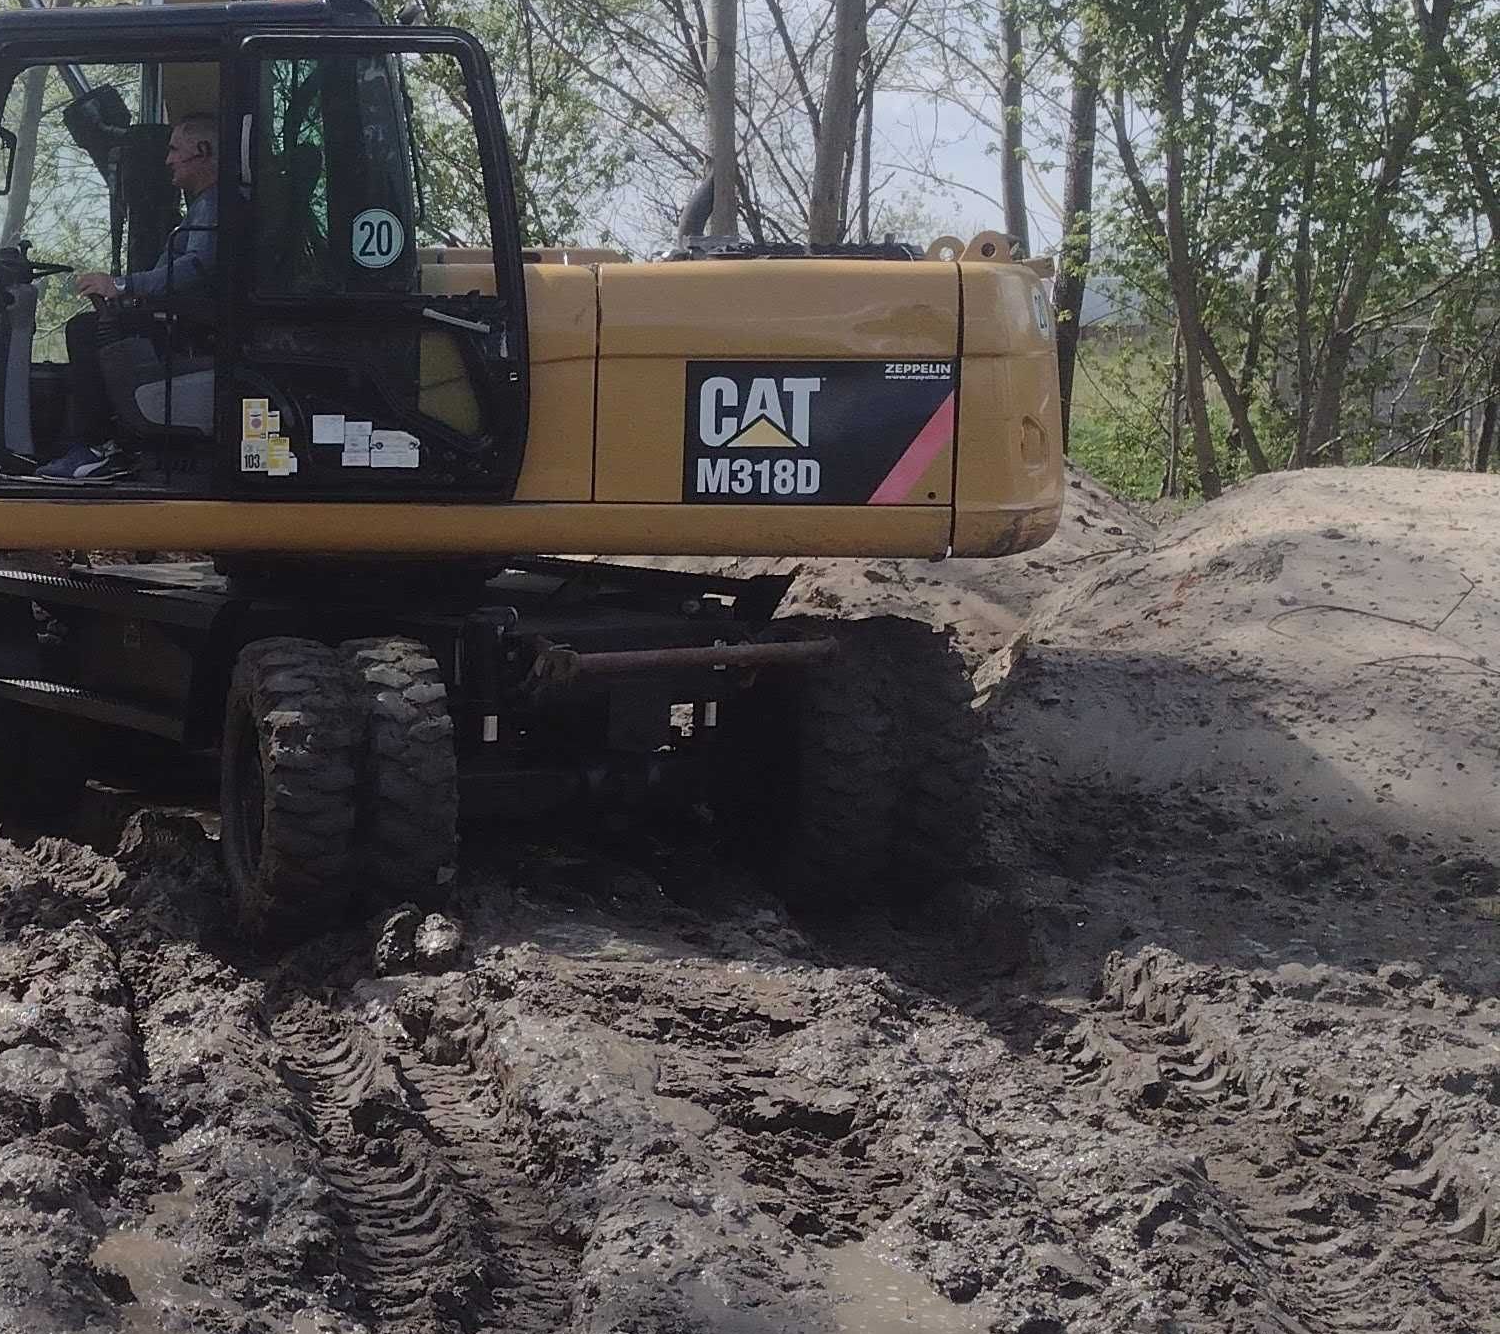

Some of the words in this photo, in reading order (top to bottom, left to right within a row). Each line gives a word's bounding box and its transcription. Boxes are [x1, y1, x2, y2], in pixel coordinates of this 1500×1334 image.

[359, 220, 392, 256] 20
[885, 363, 951, 374] ZEPPELIN
[700, 377, 821, 447] CAT
[244, 453, 260, 469] 103
[697, 458, 820, 495] M318D
